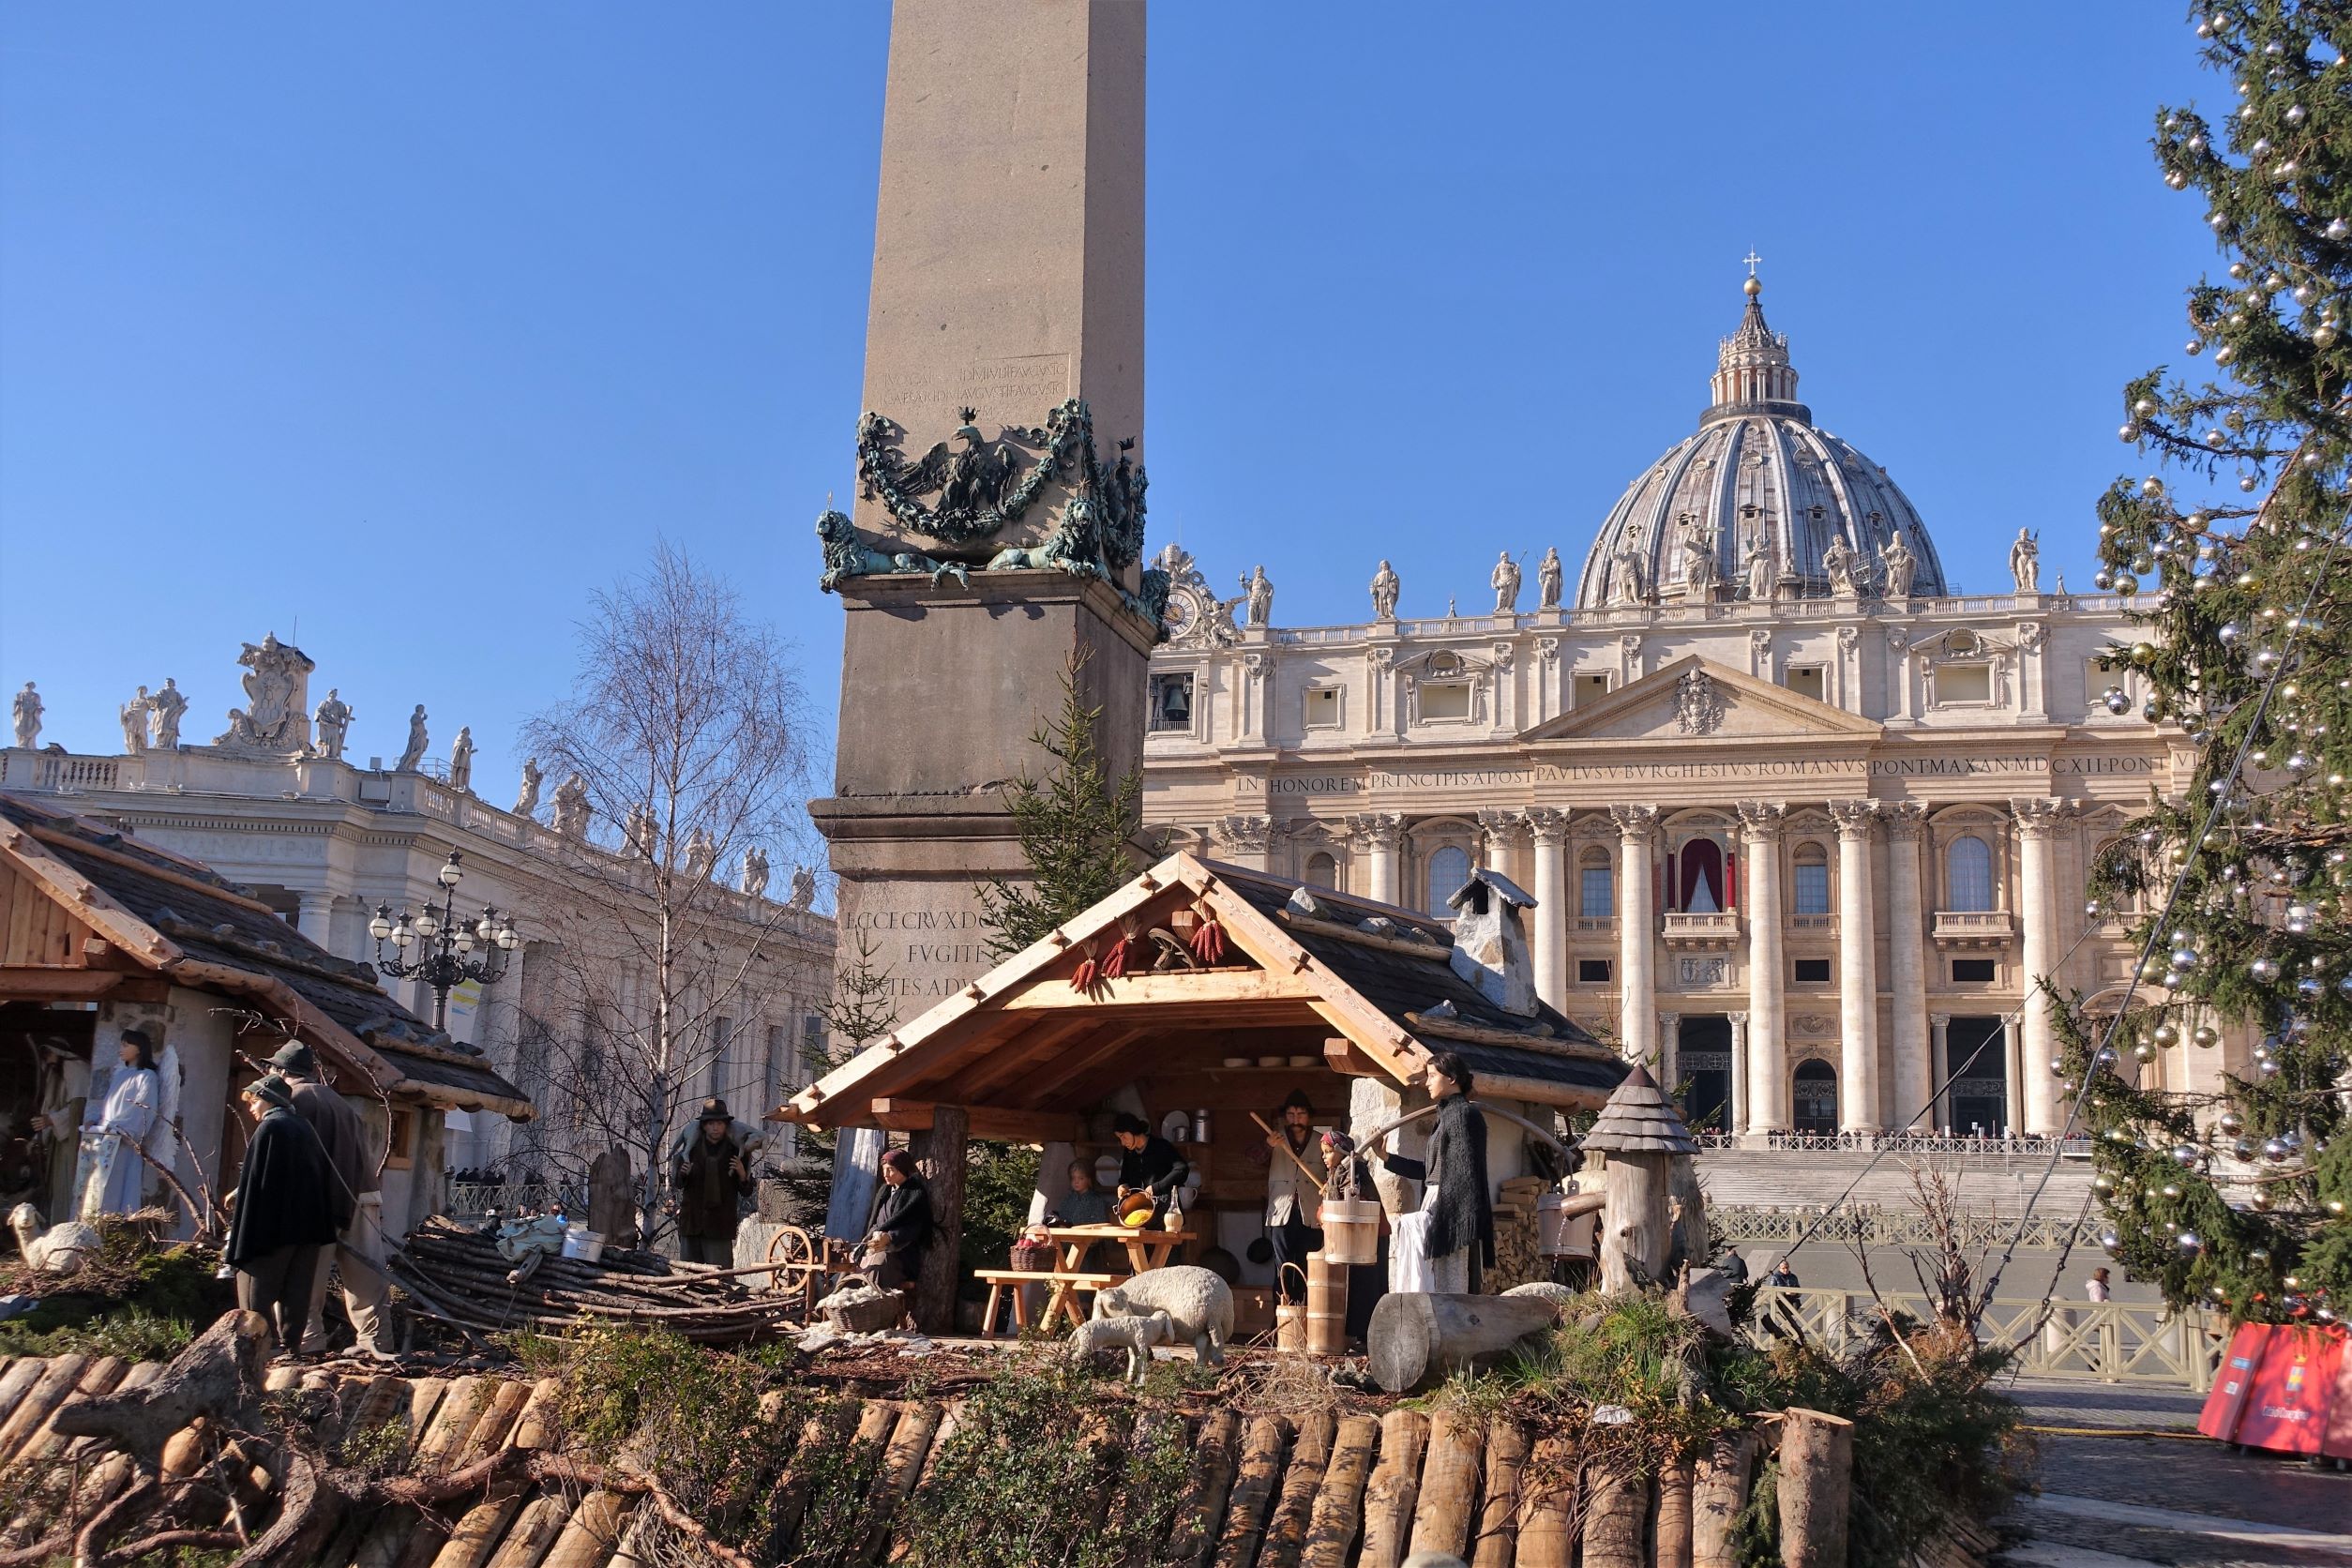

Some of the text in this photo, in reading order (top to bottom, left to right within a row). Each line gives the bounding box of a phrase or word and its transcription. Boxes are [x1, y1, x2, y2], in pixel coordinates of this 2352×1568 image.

[1238, 777, 1258, 791] IN
[1270, 777, 1365, 793] HONOREM
[1371, 771, 1469, 788] PRINCIPIS
[1473, 769, 1534, 785] APOST
[1536, 765, 1603, 780] PAVLVS
[1606, 765, 1619, 779] V
[1624, 762, 1752, 778] BVRGHESIVS
[1758, 759, 1866, 776] ROMANVS
[1873, 759, 1927, 775] PONT
[1929, 759, 1976, 774] MAX
[1980, 758, 2008, 773] AN
[2014, 756, 2101, 773] MDCXII
[2109, 756, 2168, 772] PONT
[847, 912, 897, 929] ECCE
[901, 911, 957, 929] CRVX
[908, 944, 985, 963] FVGITE
